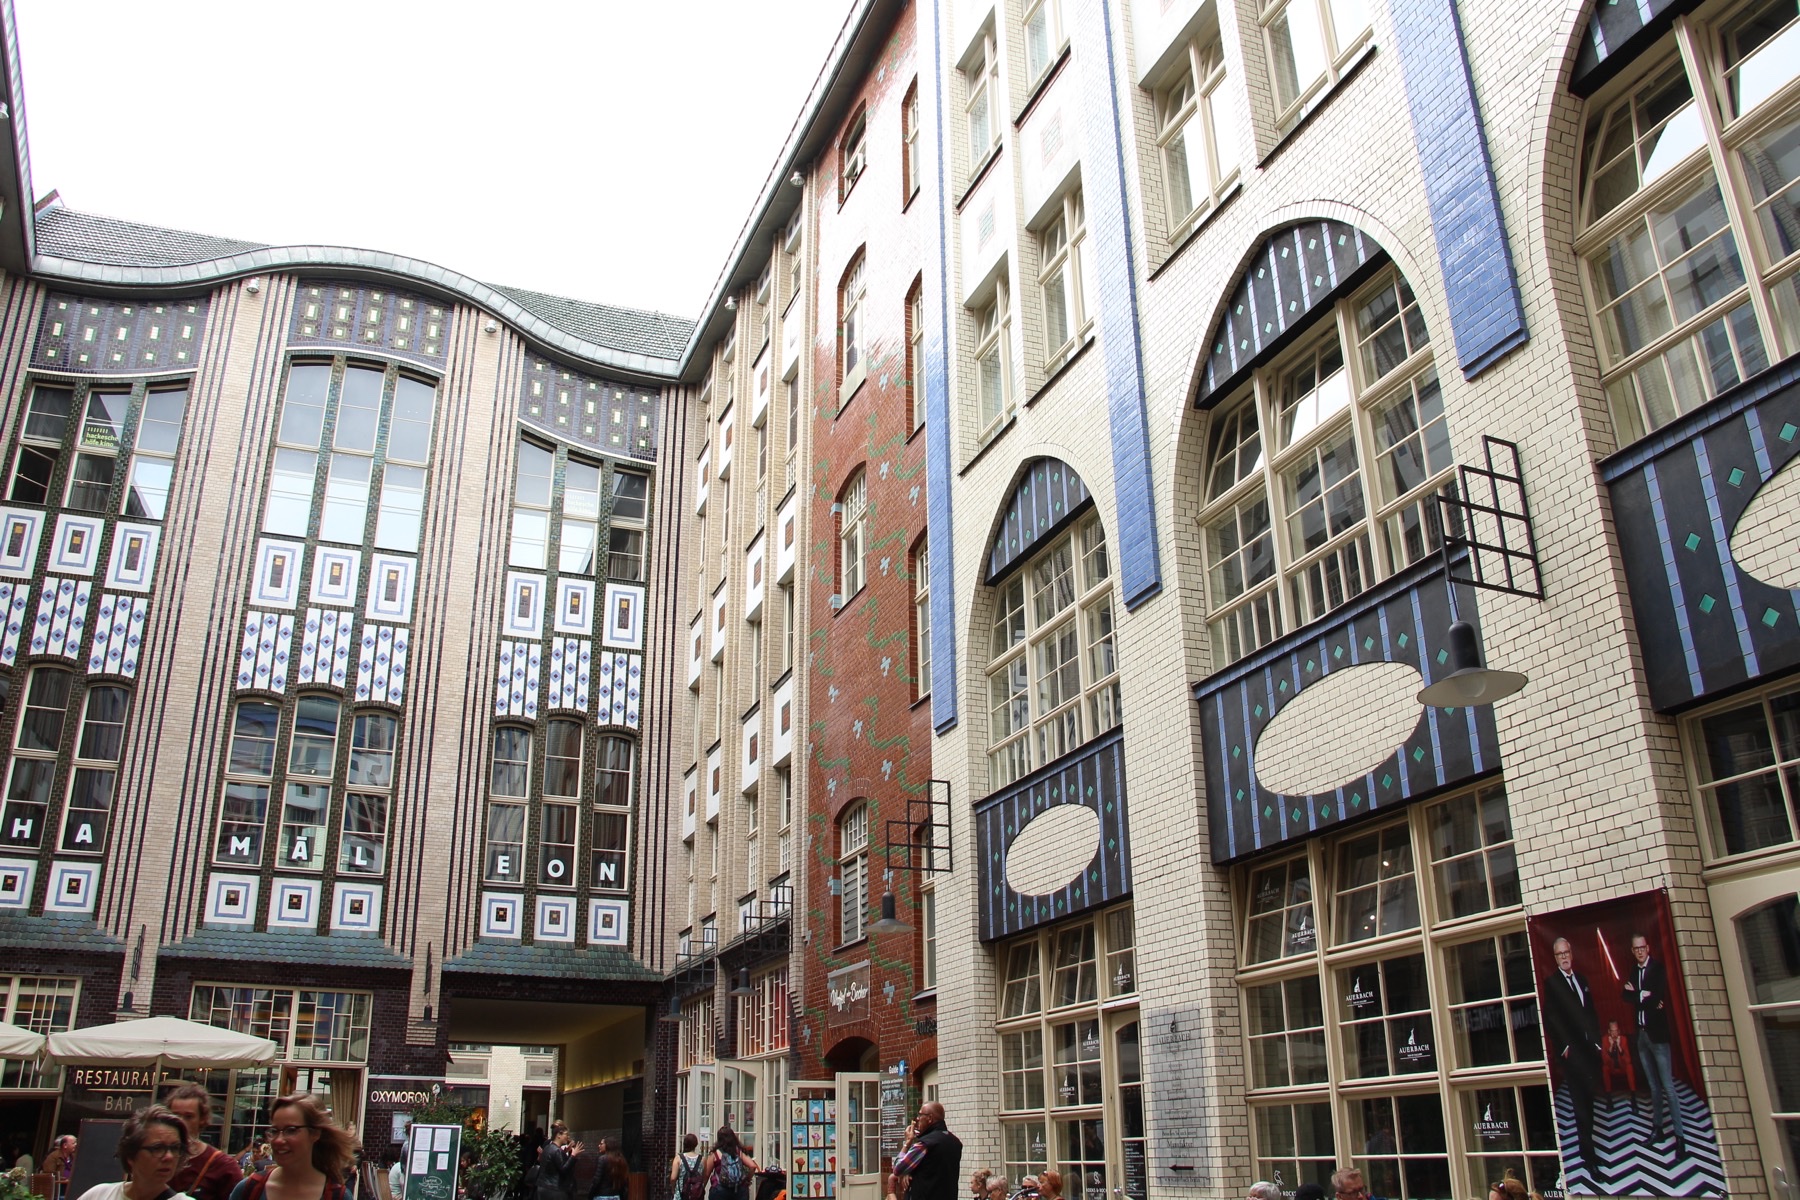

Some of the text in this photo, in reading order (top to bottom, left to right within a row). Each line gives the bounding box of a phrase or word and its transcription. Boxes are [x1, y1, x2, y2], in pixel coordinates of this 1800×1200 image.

[86, 432, 119, 441] hackesche
[1346, 991, 1374, 1001] AUERBACH
[1399, 1044, 1430, 1054] AUERBACH
[371, 1091, 430, 1103] OXYMORON
[105, 1096, 133, 1111] BAR
[1473, 1121, 1509, 1130] AUERBACH
[1543, 1190, 1564, 1198] AUER
